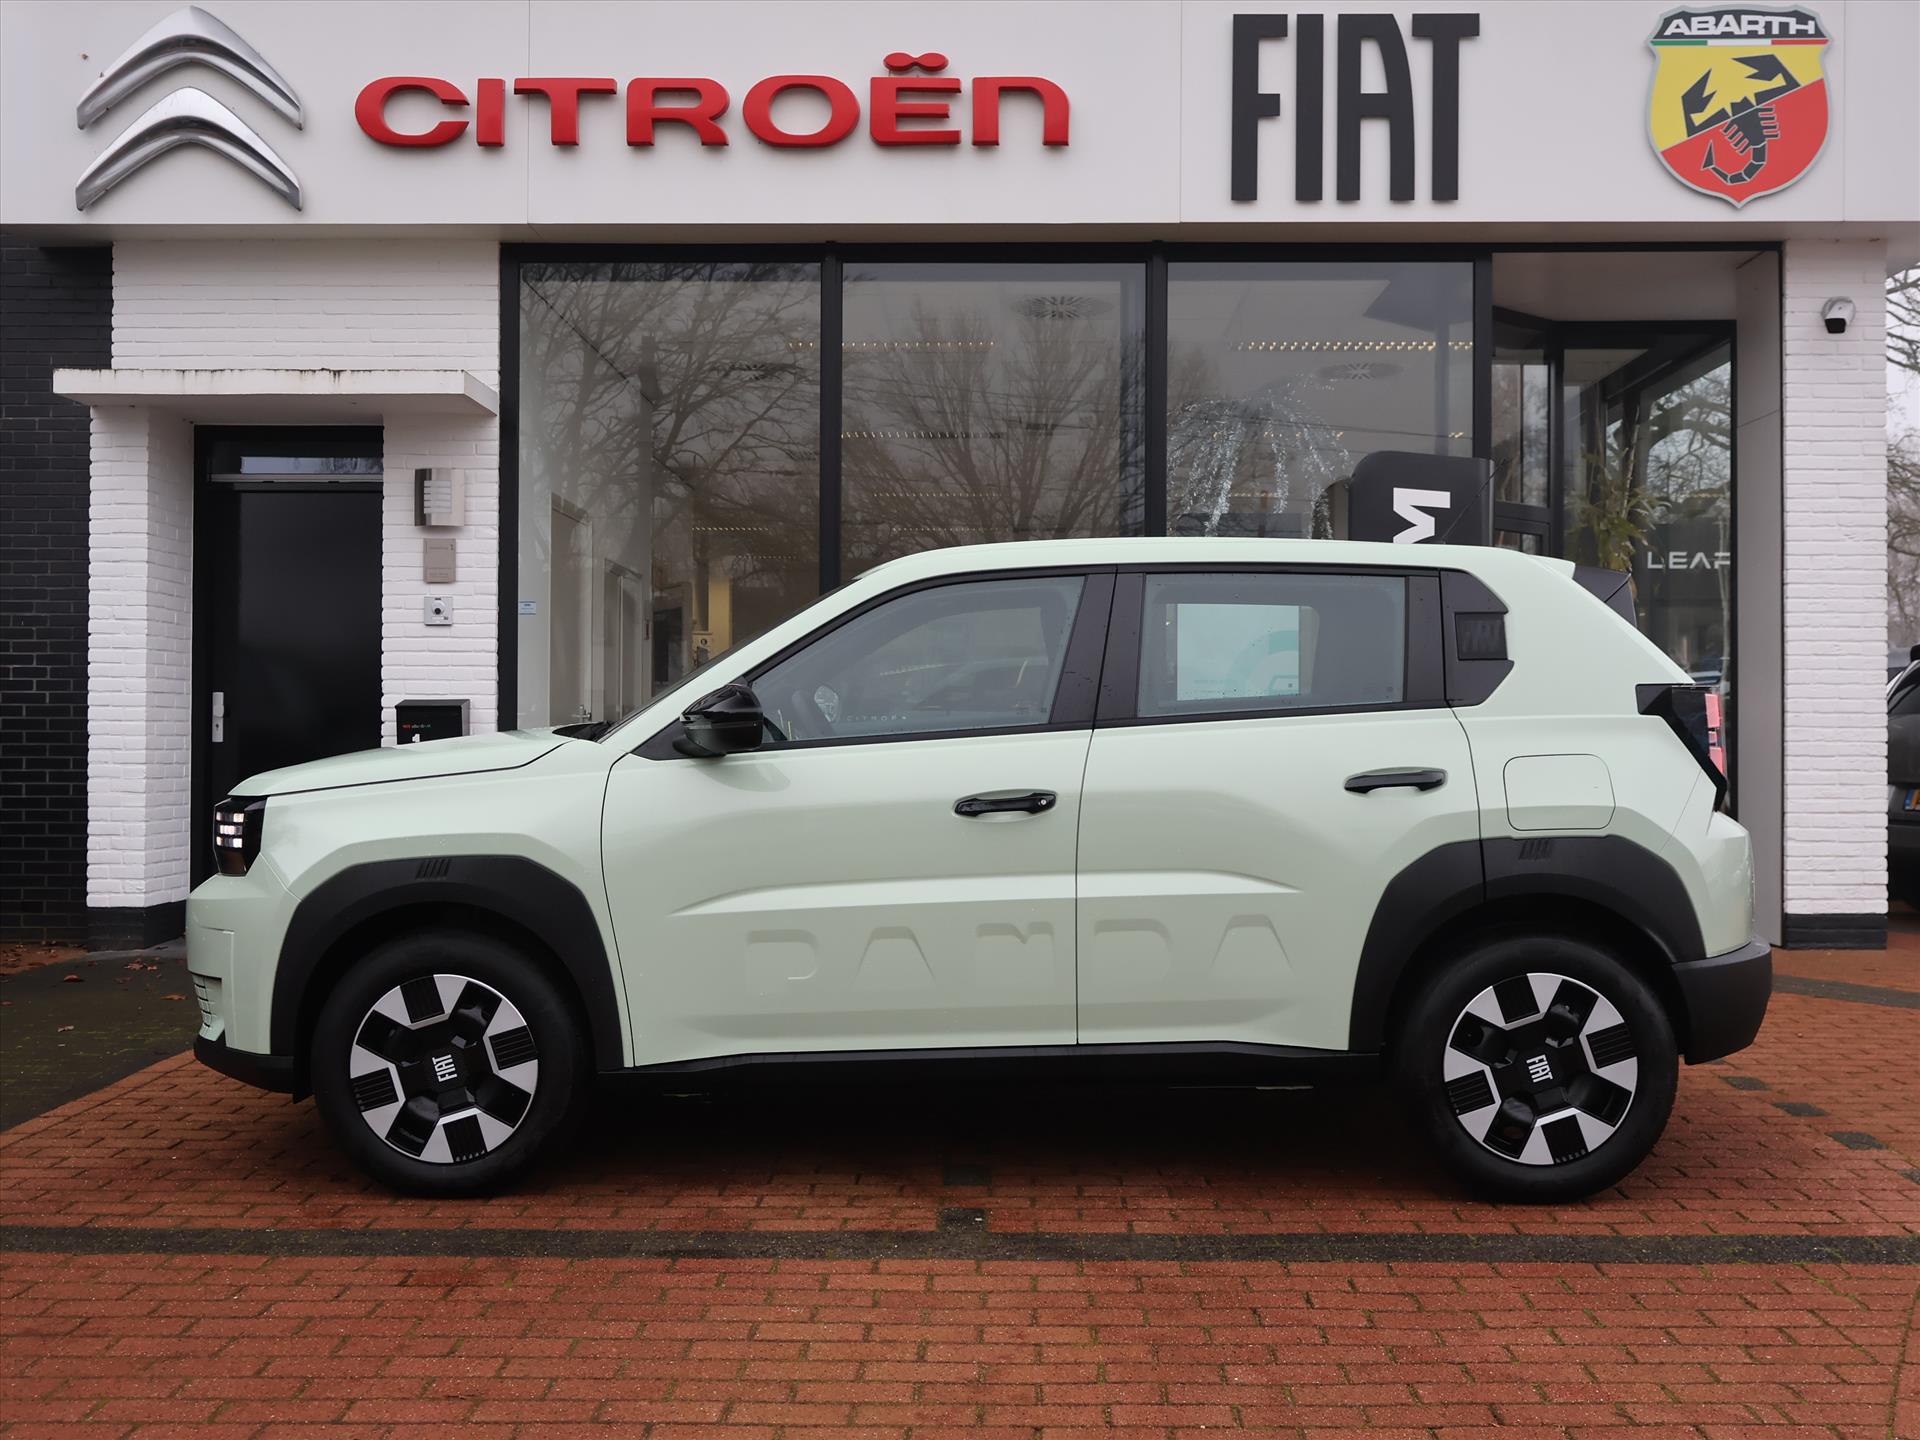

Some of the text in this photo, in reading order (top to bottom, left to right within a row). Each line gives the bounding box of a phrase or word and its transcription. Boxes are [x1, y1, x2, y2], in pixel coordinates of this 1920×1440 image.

[1663, 14, 1816, 36] ABARTH
[1231, 13, 1480, 202] FIAT
[431, 1054, 458, 1082] FIAT
[1526, 1054, 1554, 1083] FIAT
